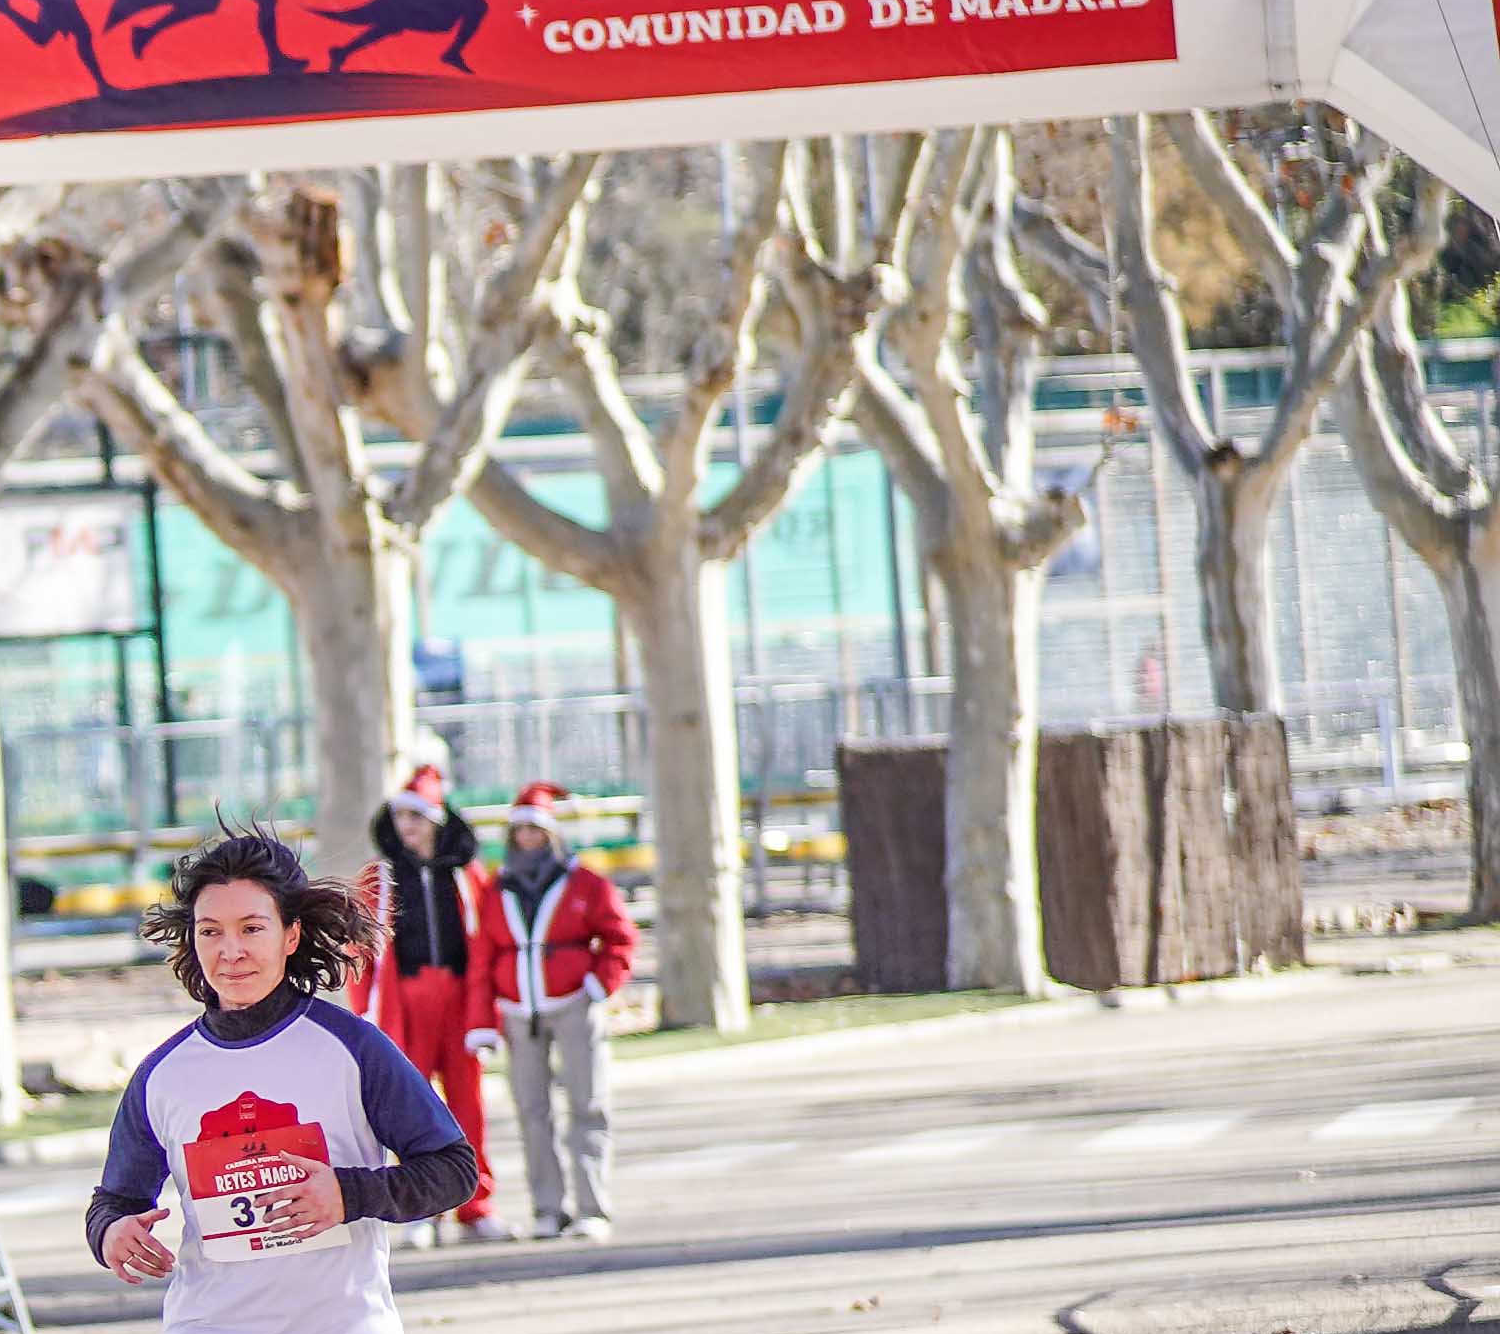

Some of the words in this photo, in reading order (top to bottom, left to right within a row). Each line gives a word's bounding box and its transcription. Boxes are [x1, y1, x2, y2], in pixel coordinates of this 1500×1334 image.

[543, 0, 846, 54] COMUNIDAD
[214, 1170, 257, 1193] REYES
[259, 1165, 307, 1186] MAGOS
